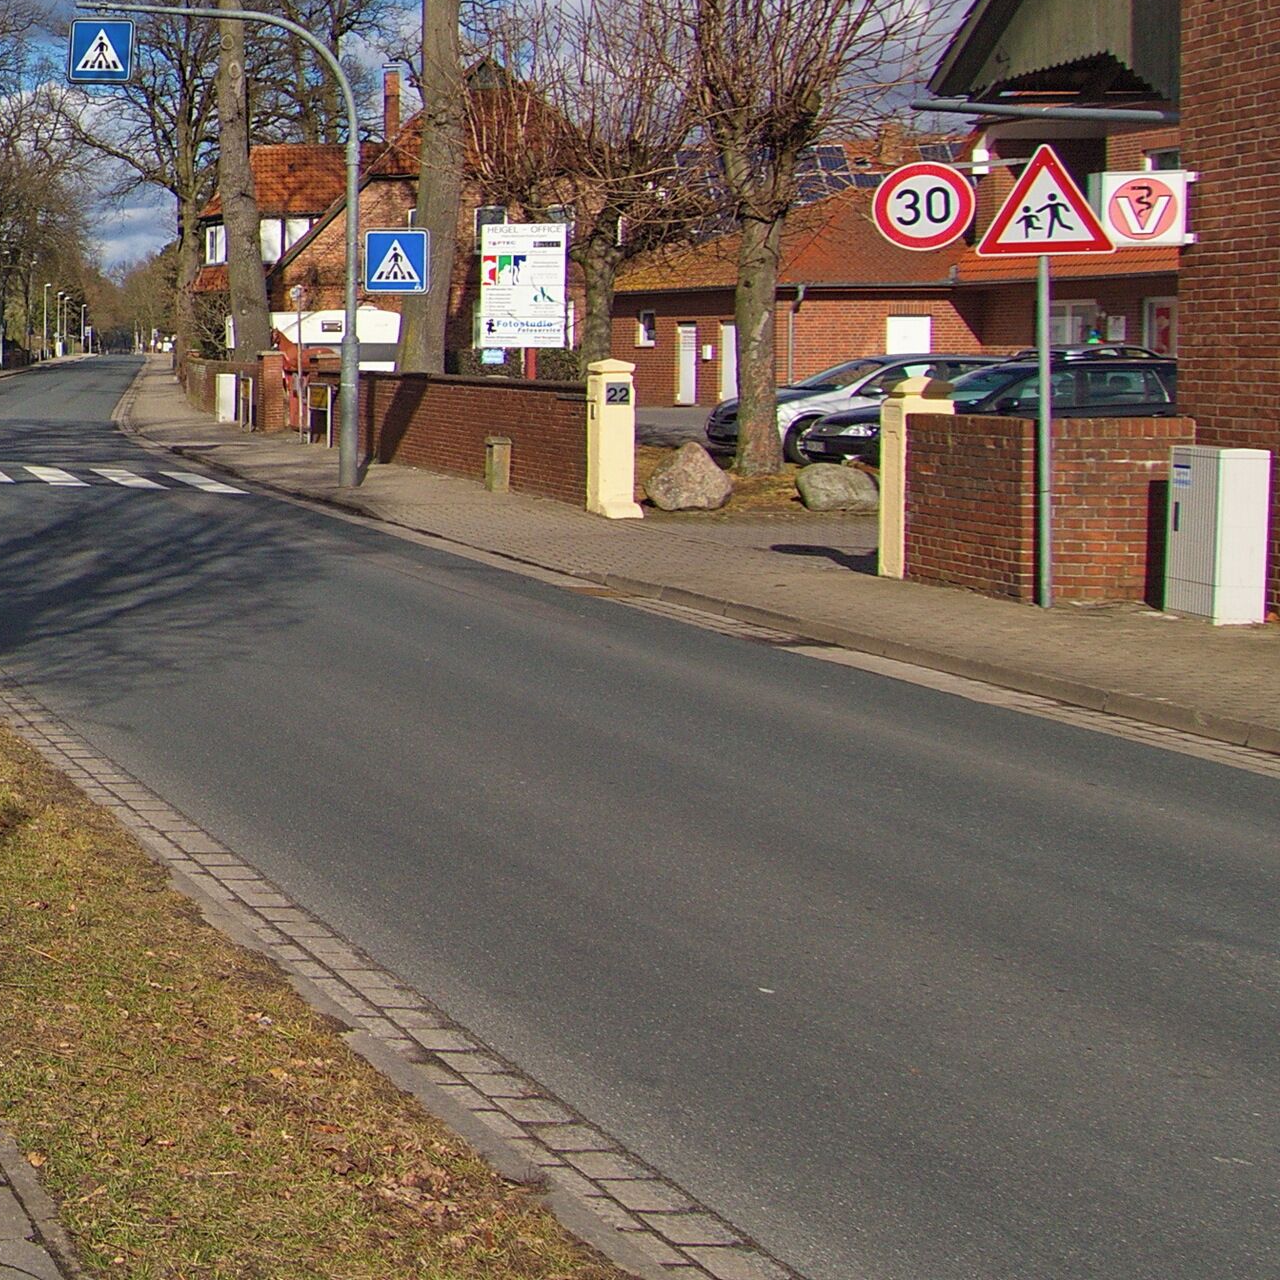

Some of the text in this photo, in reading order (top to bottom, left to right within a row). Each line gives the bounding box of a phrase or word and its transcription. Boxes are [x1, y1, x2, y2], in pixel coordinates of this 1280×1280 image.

[895, 186, 950, 226] 30
[487, 225, 519, 234] HEIGEL
[530, 225, 563, 233] OFFICE
[496, 320, 553, 328] Fotostudio
[607, 387, 630, 402] 22
